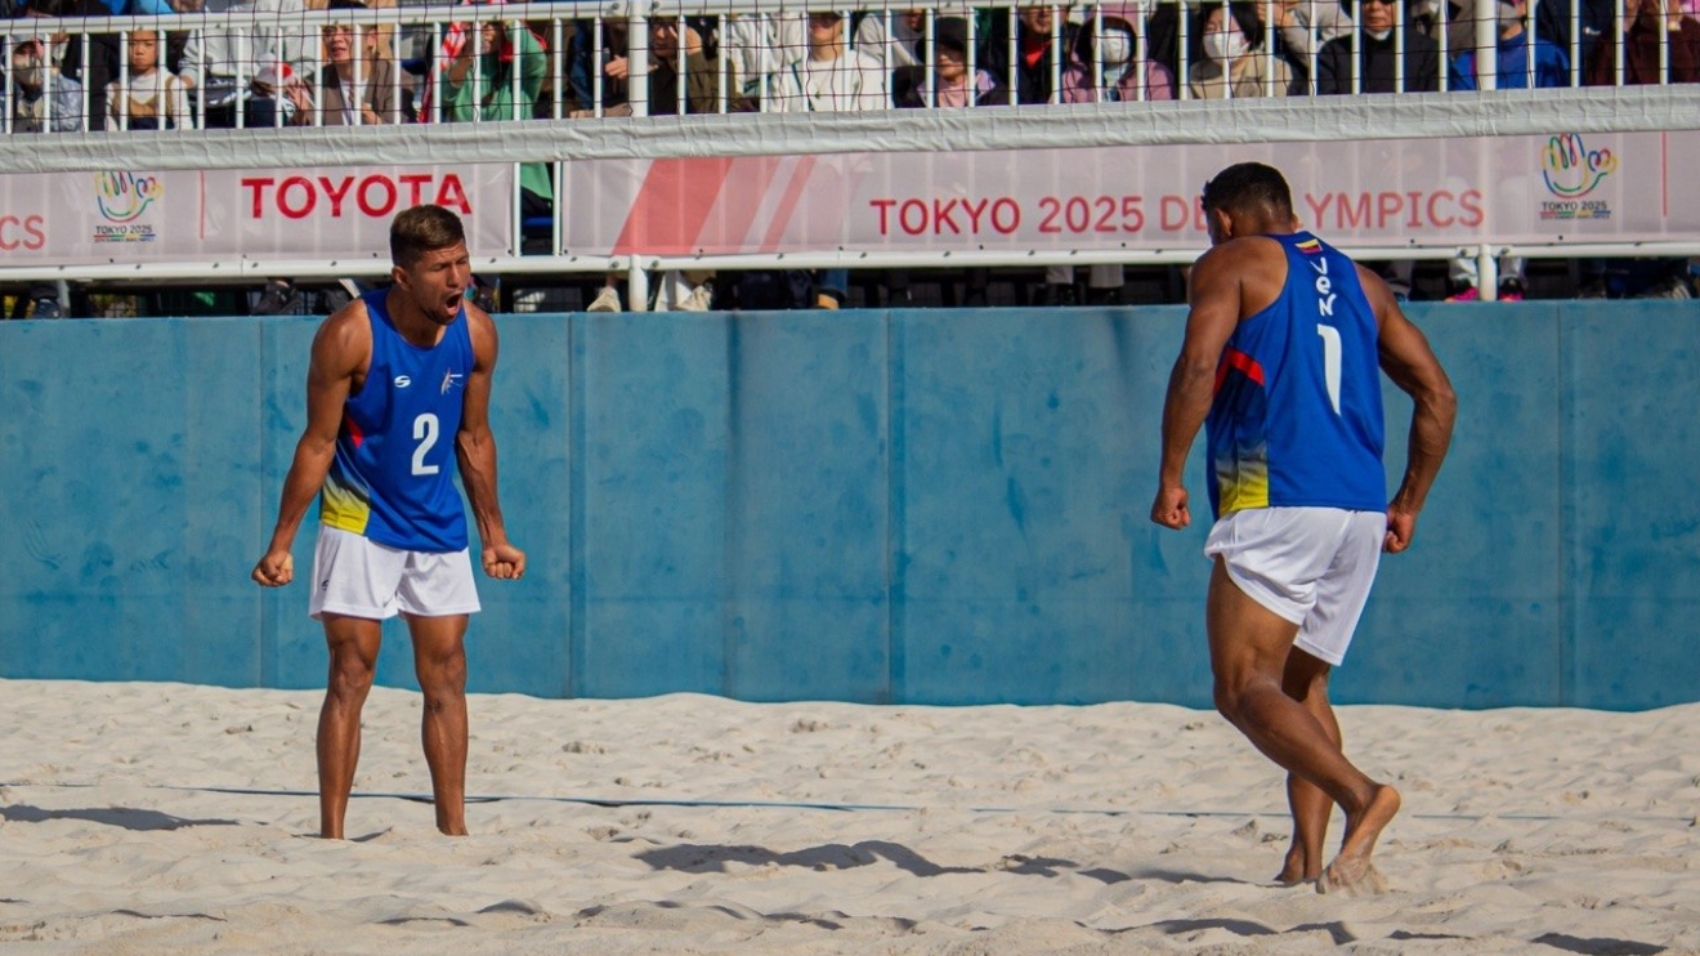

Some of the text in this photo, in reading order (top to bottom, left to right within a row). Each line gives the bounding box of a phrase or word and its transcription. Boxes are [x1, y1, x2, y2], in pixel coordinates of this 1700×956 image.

[241, 174, 472, 218] TOYOTA
[870, 190, 1484, 235] TOKYO 2025 DEYMPICS
[1542, 201, 1578, 211] TOKYO
[96, 225, 127, 234] TOKYO
[1317, 323, 1342, 416] 1
[411, 412, 440, 476] 2
